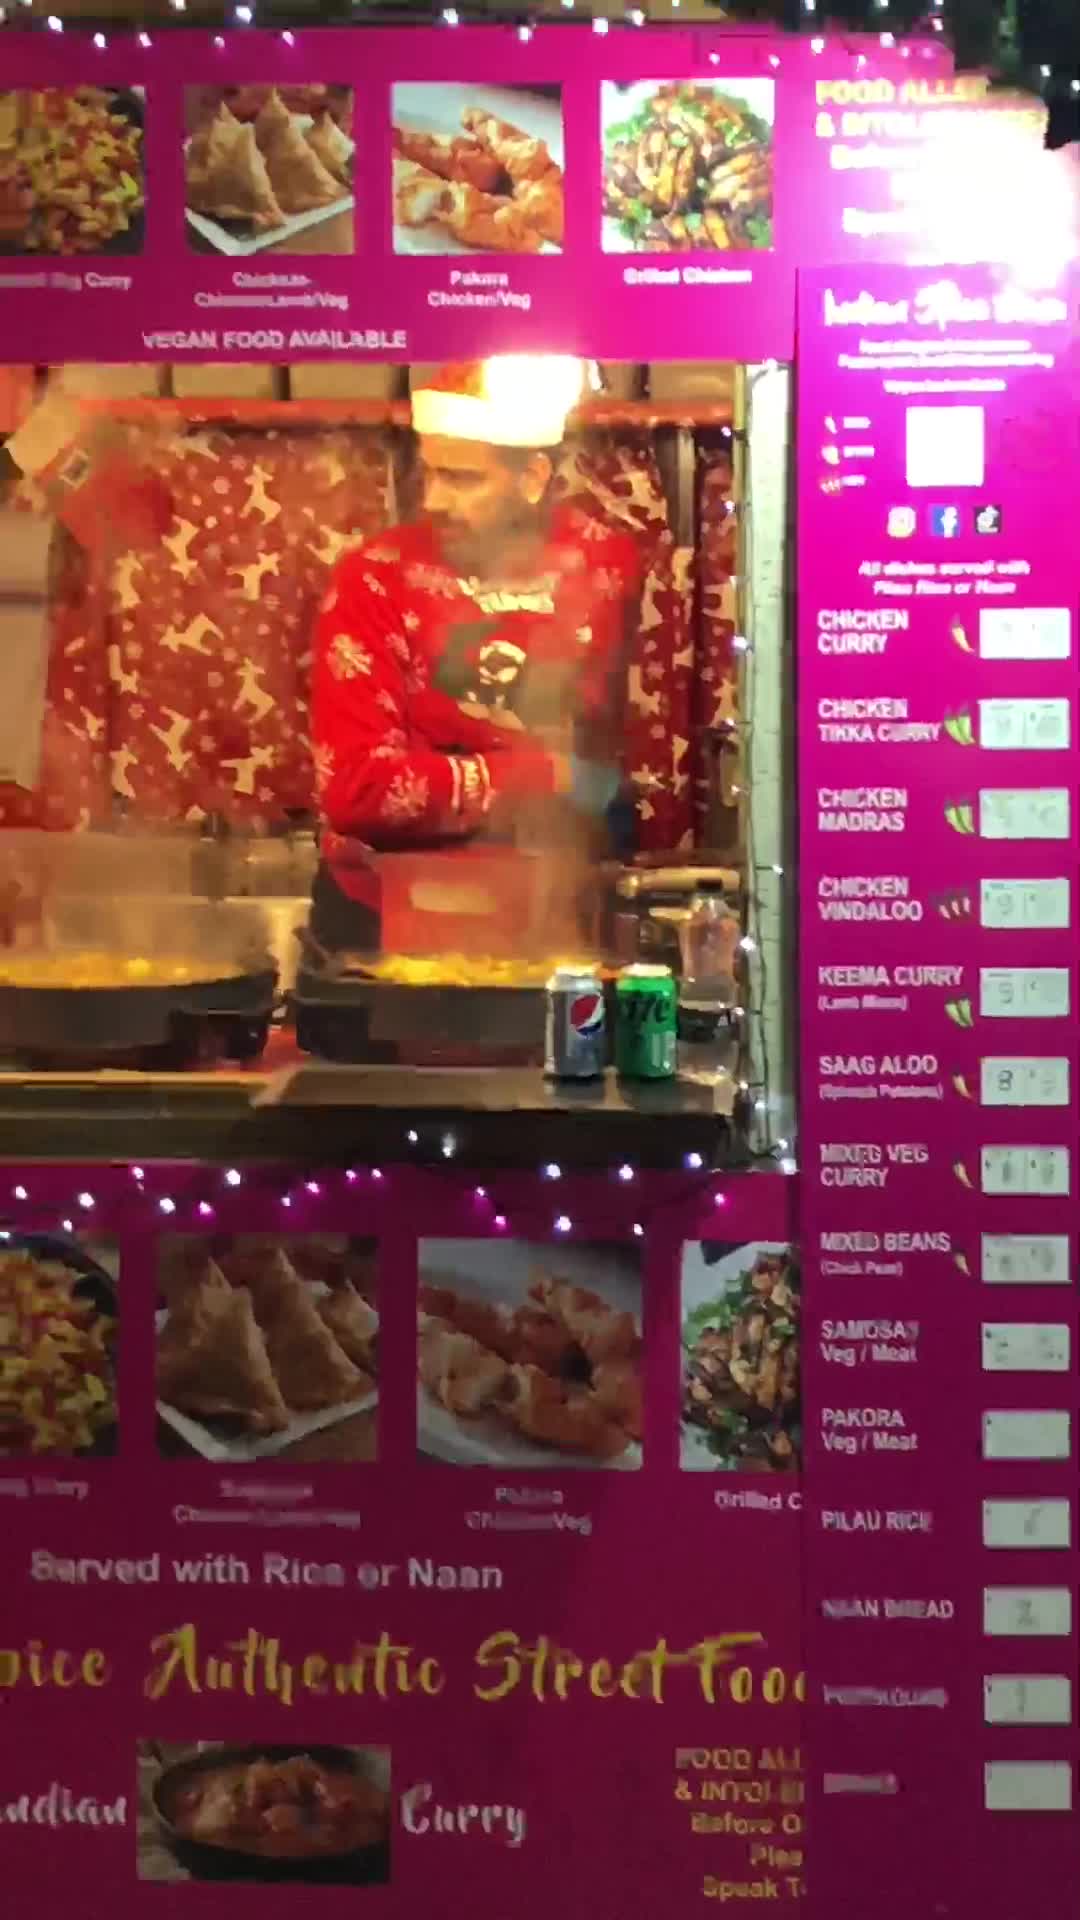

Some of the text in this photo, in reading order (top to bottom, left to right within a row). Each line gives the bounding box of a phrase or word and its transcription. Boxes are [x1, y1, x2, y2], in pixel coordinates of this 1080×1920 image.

[143, 330, 408, 349] VEGAN FOOD AVAILABLE
[817, 609, 909, 631] CHICKEN
[818, 633, 888, 655] CURRY
[817, 698, 908, 720] CHICKEN
[818, 722, 942, 743] TIKKA CURRY
[817, 787, 908, 809] CHICKEN
[818, 811, 905, 832] MADRAS
[818, 876, 909, 898] CHICKEN
[818, 901, 923, 922] VINDALOO
[818, 964, 964, 987] KEEMA CURRY
[819, 1055, 938, 1076] SAAG ALOO
[886, 1144, 929, 1164] VEG
[820, 1167, 889, 1187] CURRY
[883, 1232, 951, 1252] BEANS
[820, 1343, 856, 1366] Veg
[872, 1343, 917, 1363] Meat
[821, 1408, 906, 1428] PAKORA
[821, 1432, 856, 1454] Veg
[872, 1432, 918, 1451] Meat
[821, 1510, 880, 1532] PILAU
[173, 1553, 250, 1584] with
[357, 1562, 400, 1588] or
[408, 1557, 504, 1591] Naan
[145, 1623, 445, 1705] Authentic
[474, 1629, 690, 1704] Street
[675, 1747, 751, 1771] FOOD
[674, 1777, 693, 1801] &
[402, 1782, 526, 1848] Curry
